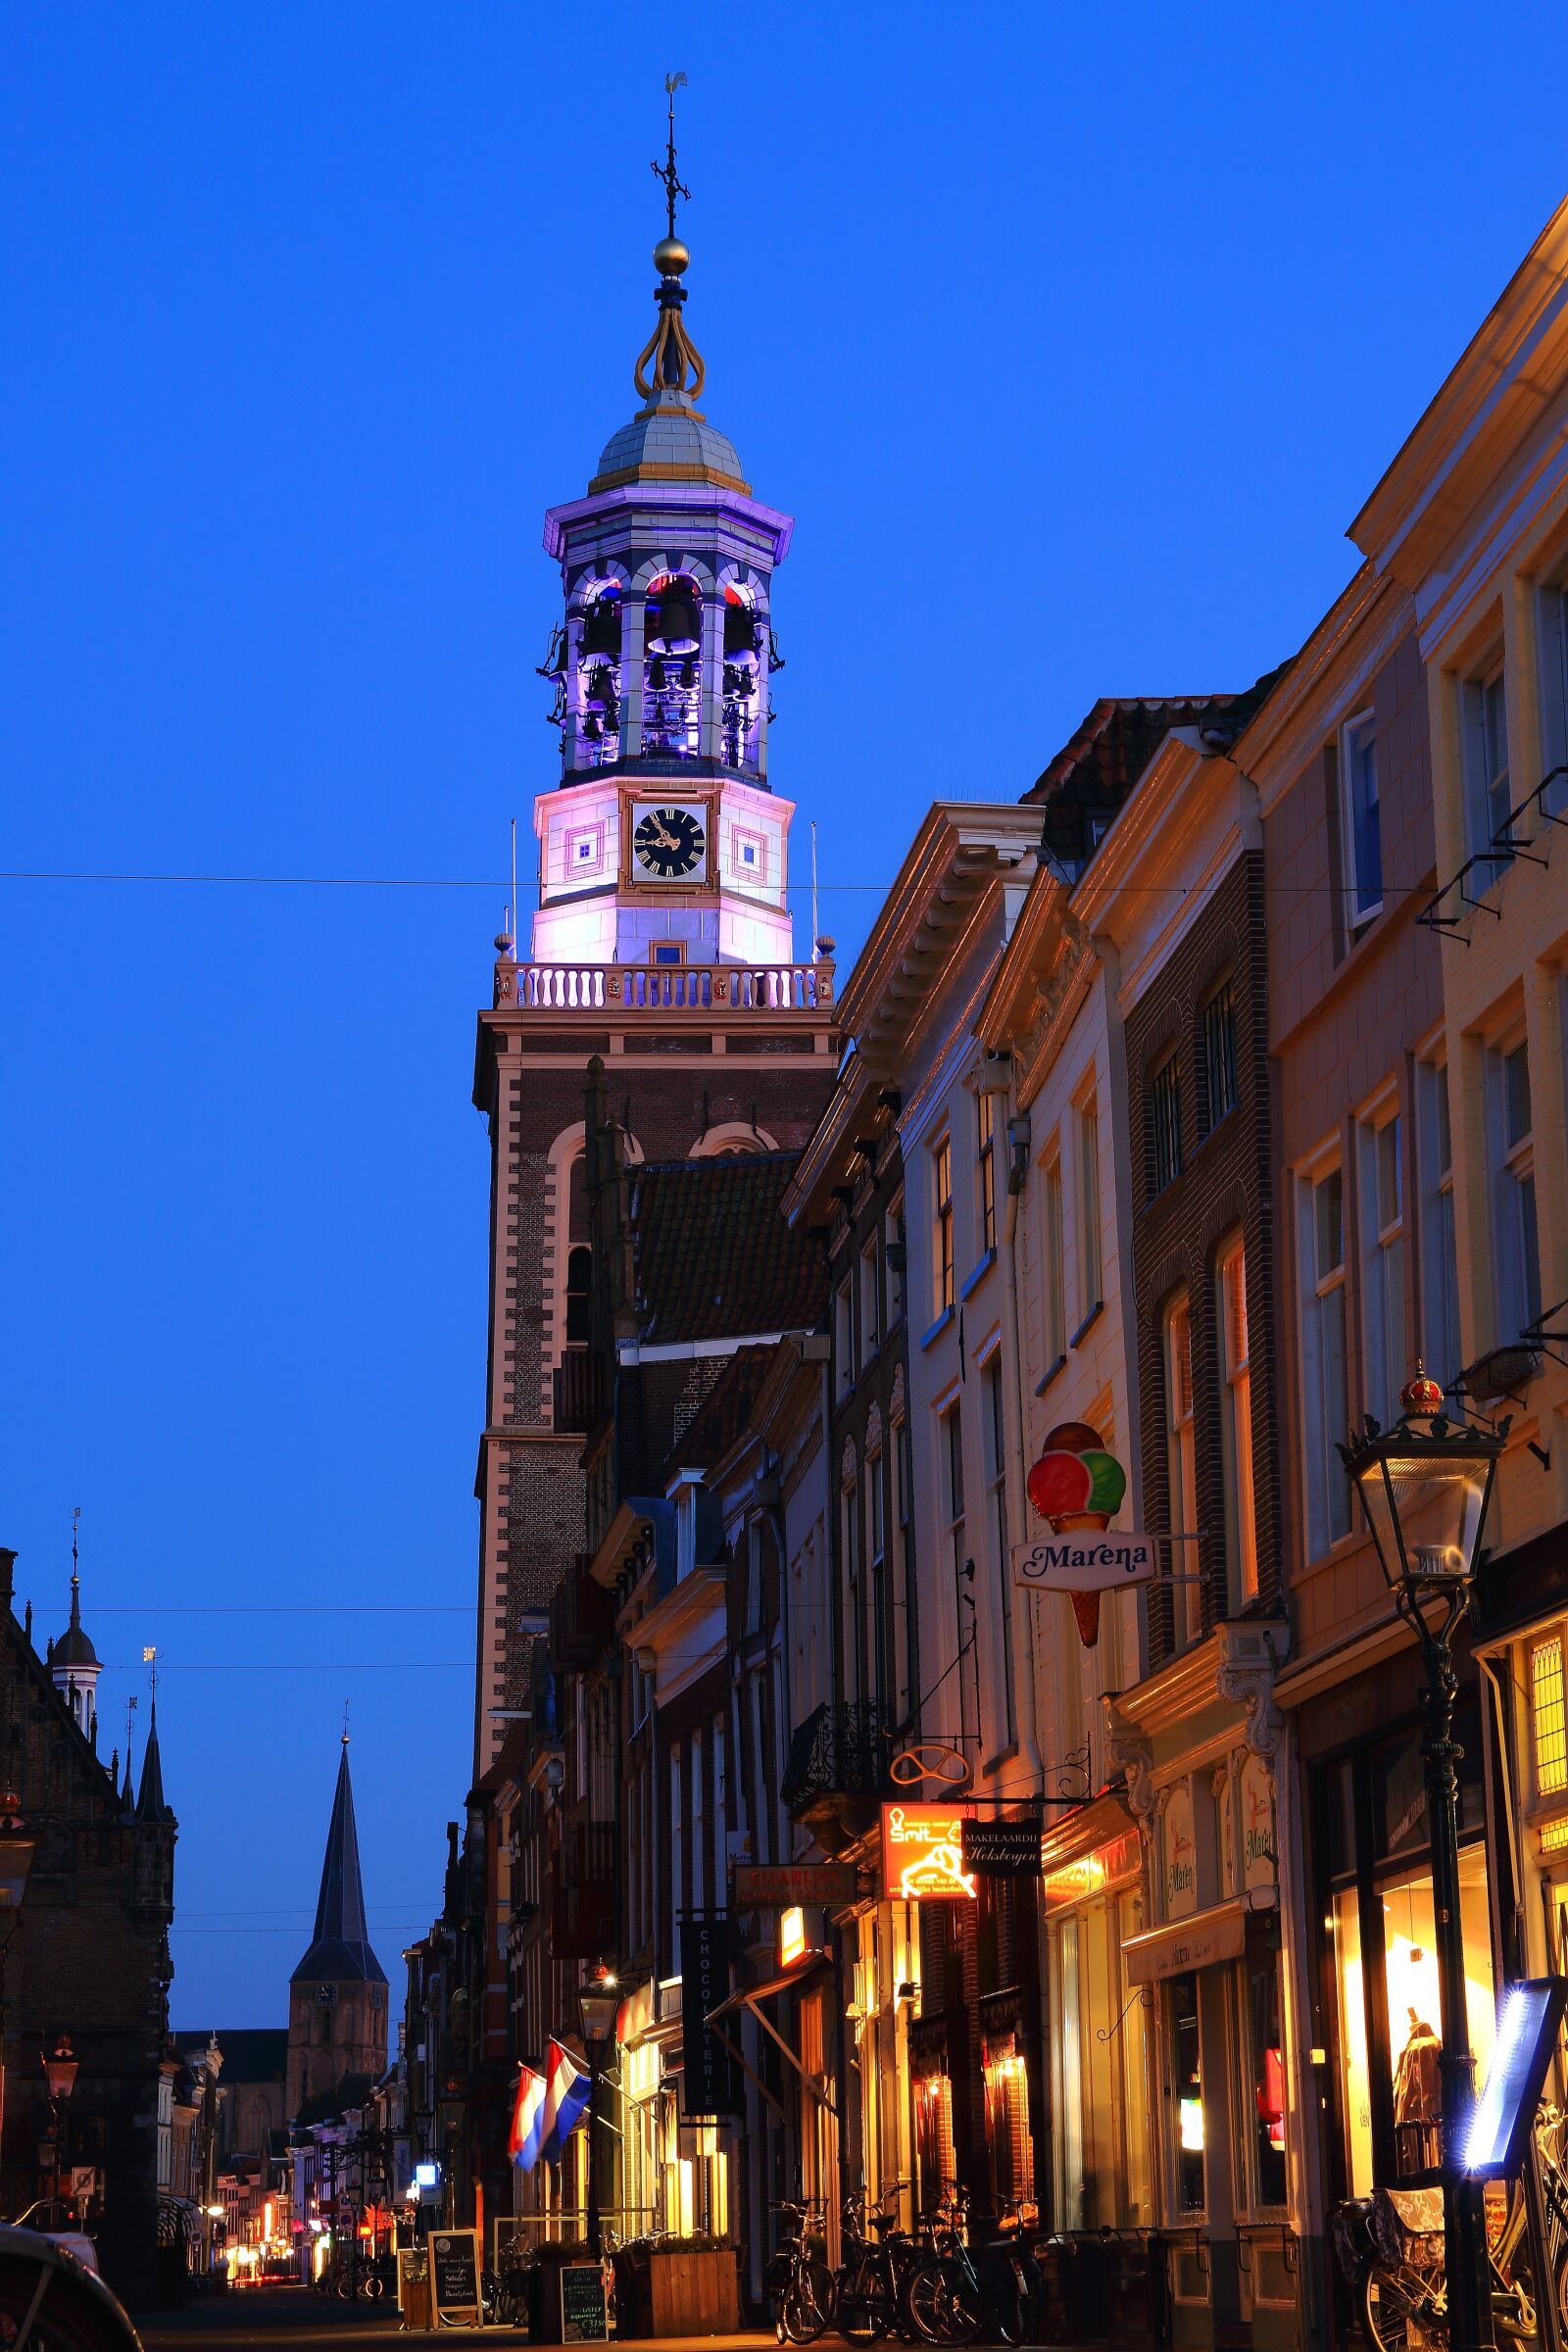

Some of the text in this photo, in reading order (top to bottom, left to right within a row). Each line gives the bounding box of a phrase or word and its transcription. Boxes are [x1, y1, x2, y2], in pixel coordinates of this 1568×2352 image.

[1022, 1544, 1148, 1578] Marena
[890, 1827, 947, 1842] Smit
[965, 1834, 1037, 1842] MAKELAARDIJ
[966, 1846, 1037, 1866] Hoksbergen
[700, 1930, 713, 2106] CHOCOLATERIE
